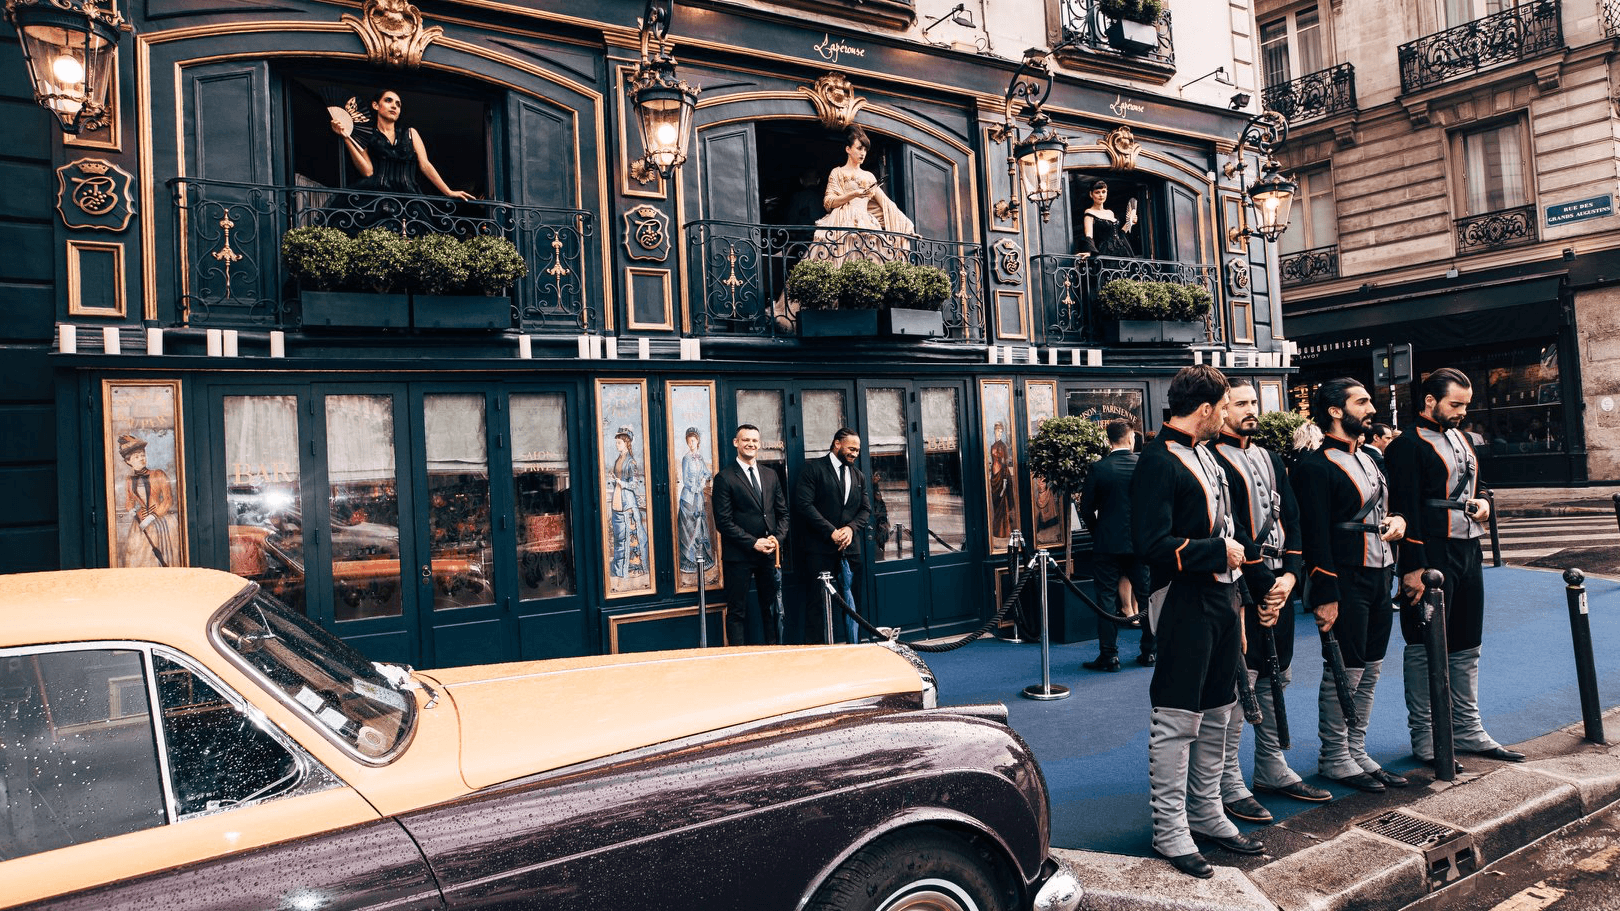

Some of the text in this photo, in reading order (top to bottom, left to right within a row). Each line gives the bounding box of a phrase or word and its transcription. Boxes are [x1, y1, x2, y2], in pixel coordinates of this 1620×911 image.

[813, 33, 865, 62] Lapérouse
[1109, 94, 1144, 118] Lapérouse
[1548, 206, 1611, 222] GRANDS AUGUSTINS
[1102, 404, 1138, 423] PARISIENNE
[232, 463, 294, 485] BAR
